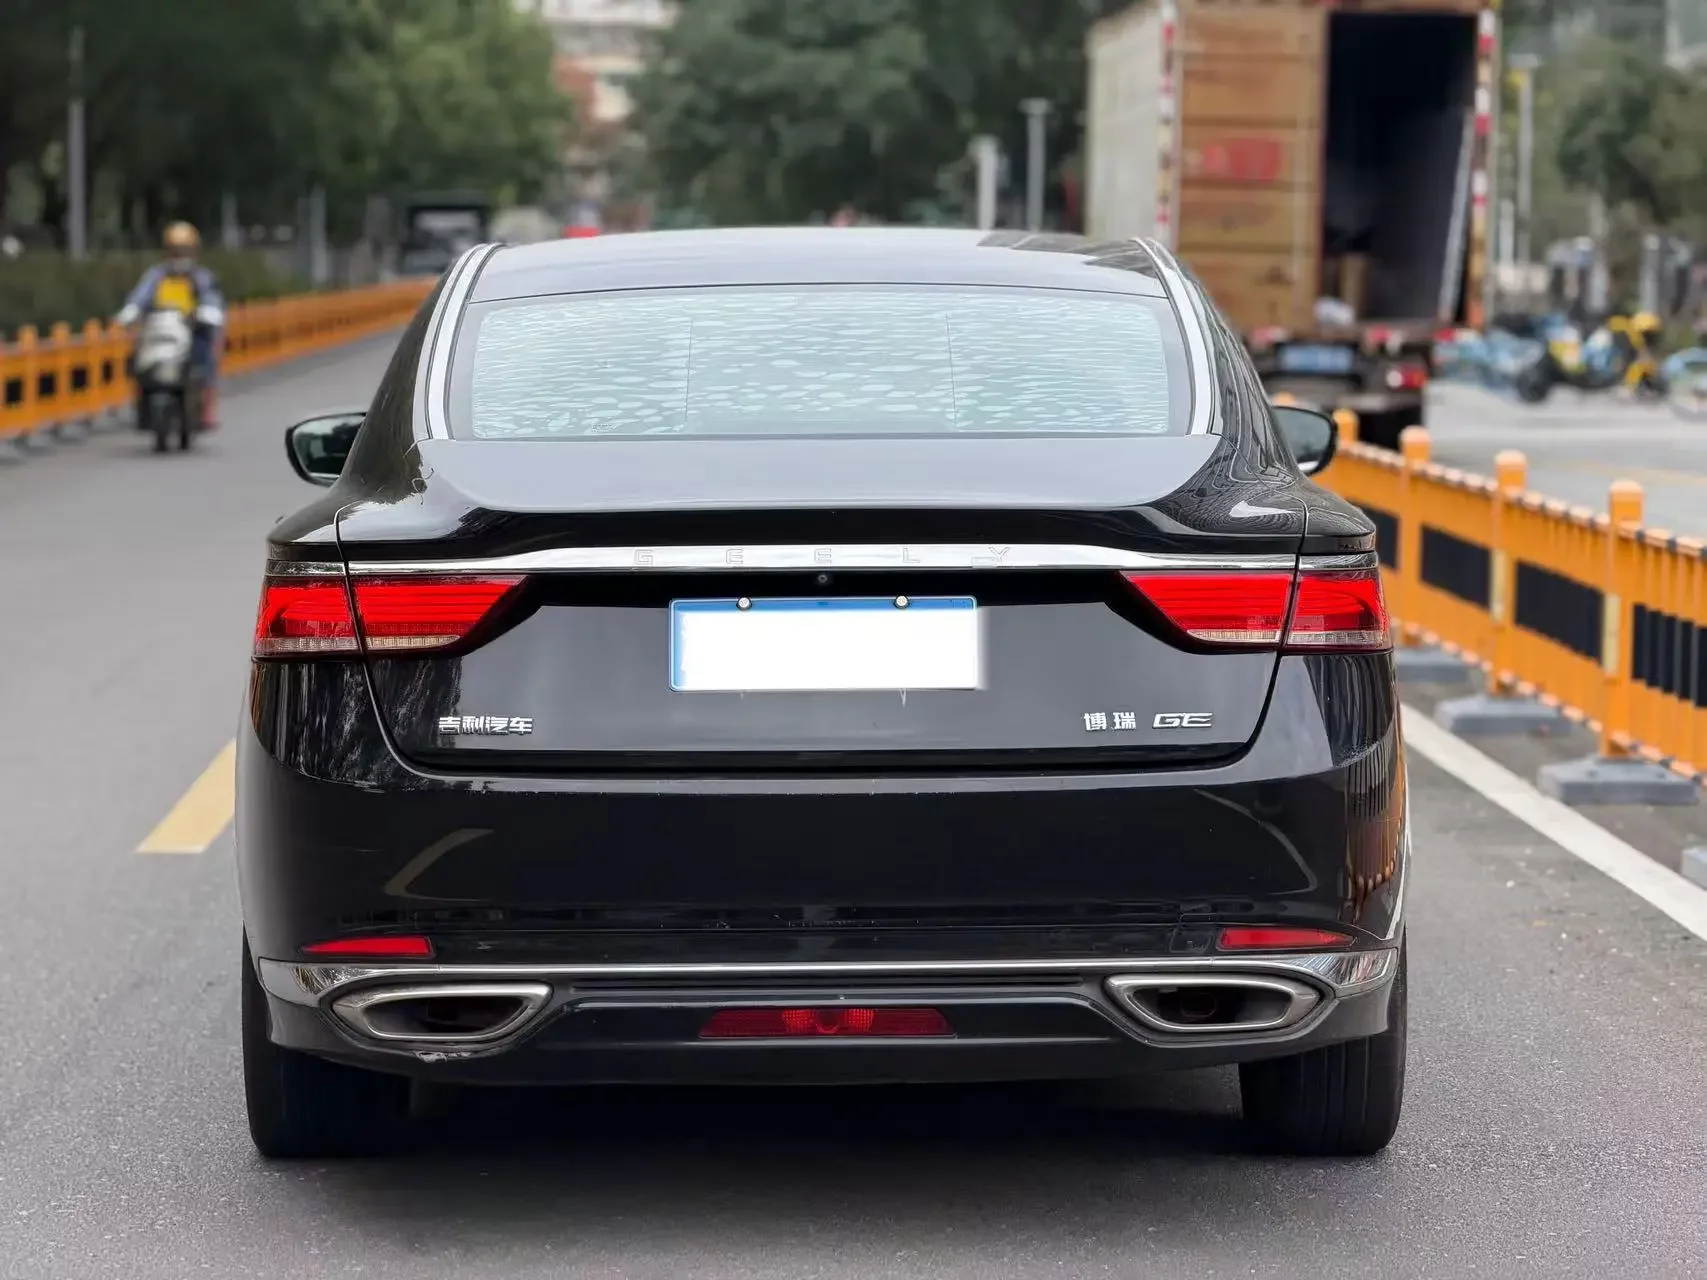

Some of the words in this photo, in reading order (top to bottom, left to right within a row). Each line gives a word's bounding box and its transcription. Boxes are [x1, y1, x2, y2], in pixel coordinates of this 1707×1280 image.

[634, 547, 1011, 566] GEELY
[439, 715, 533, 734] 吉利汽车
[1083, 711, 1137, 731] 博瑞
[1152, 712, 1213, 729] GE
